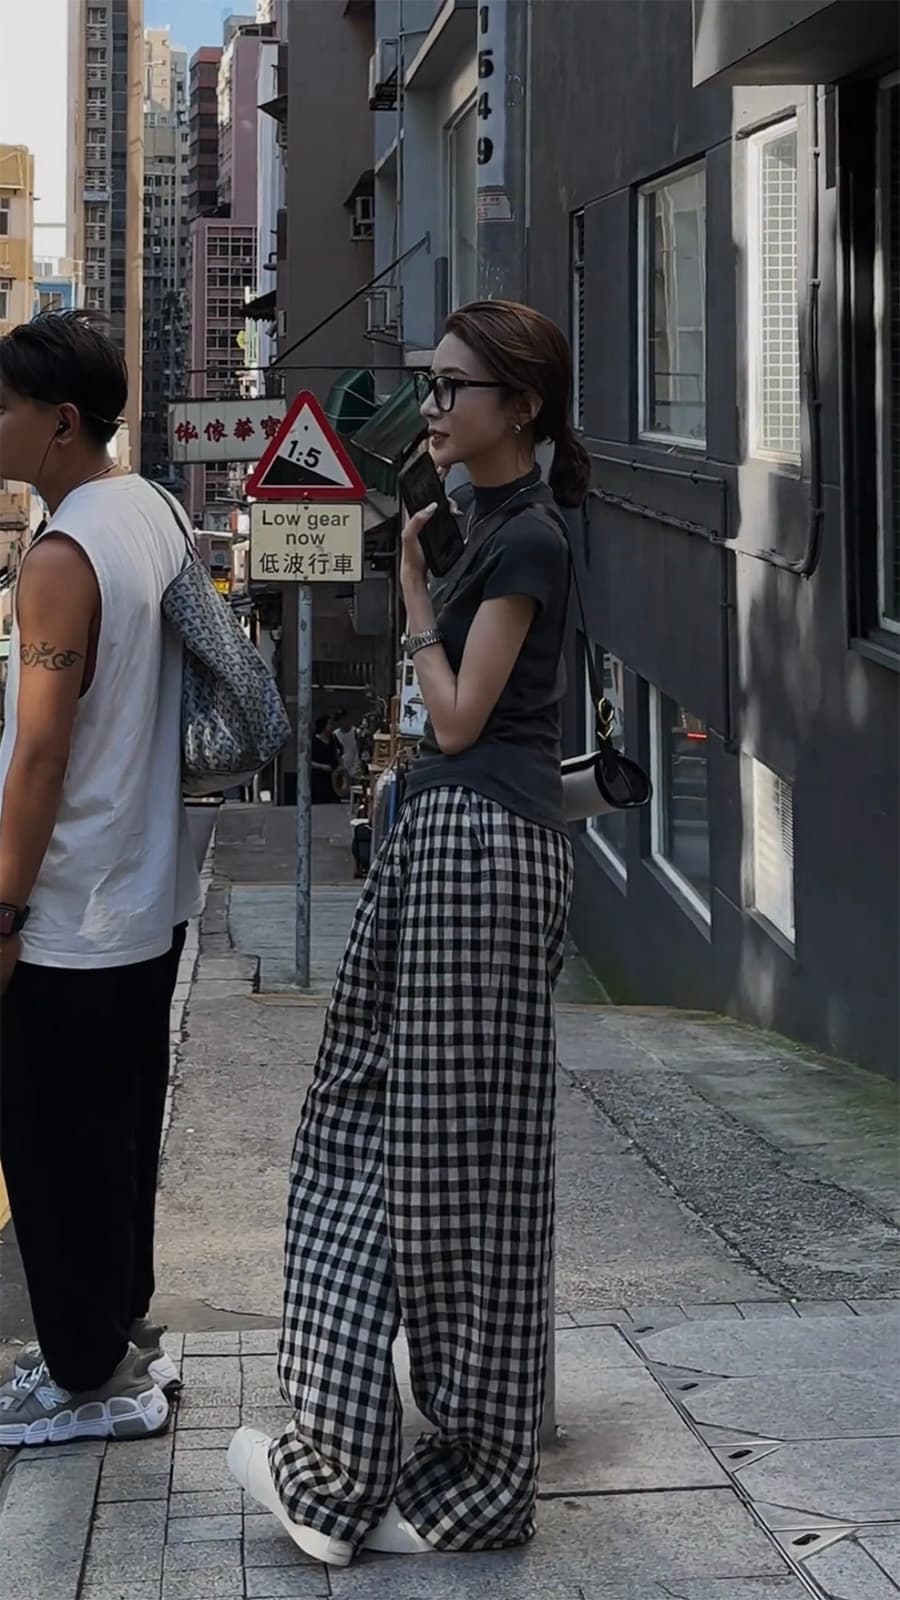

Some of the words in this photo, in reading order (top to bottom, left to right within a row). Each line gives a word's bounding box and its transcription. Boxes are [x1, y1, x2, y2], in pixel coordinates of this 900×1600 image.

[287, 440, 322, 468] 1:5
[262, 510, 301, 526] Low
[307, 513, 350, 530] gear
[286, 532, 326, 545] now
[259, 552, 354, 575] 低波行車
